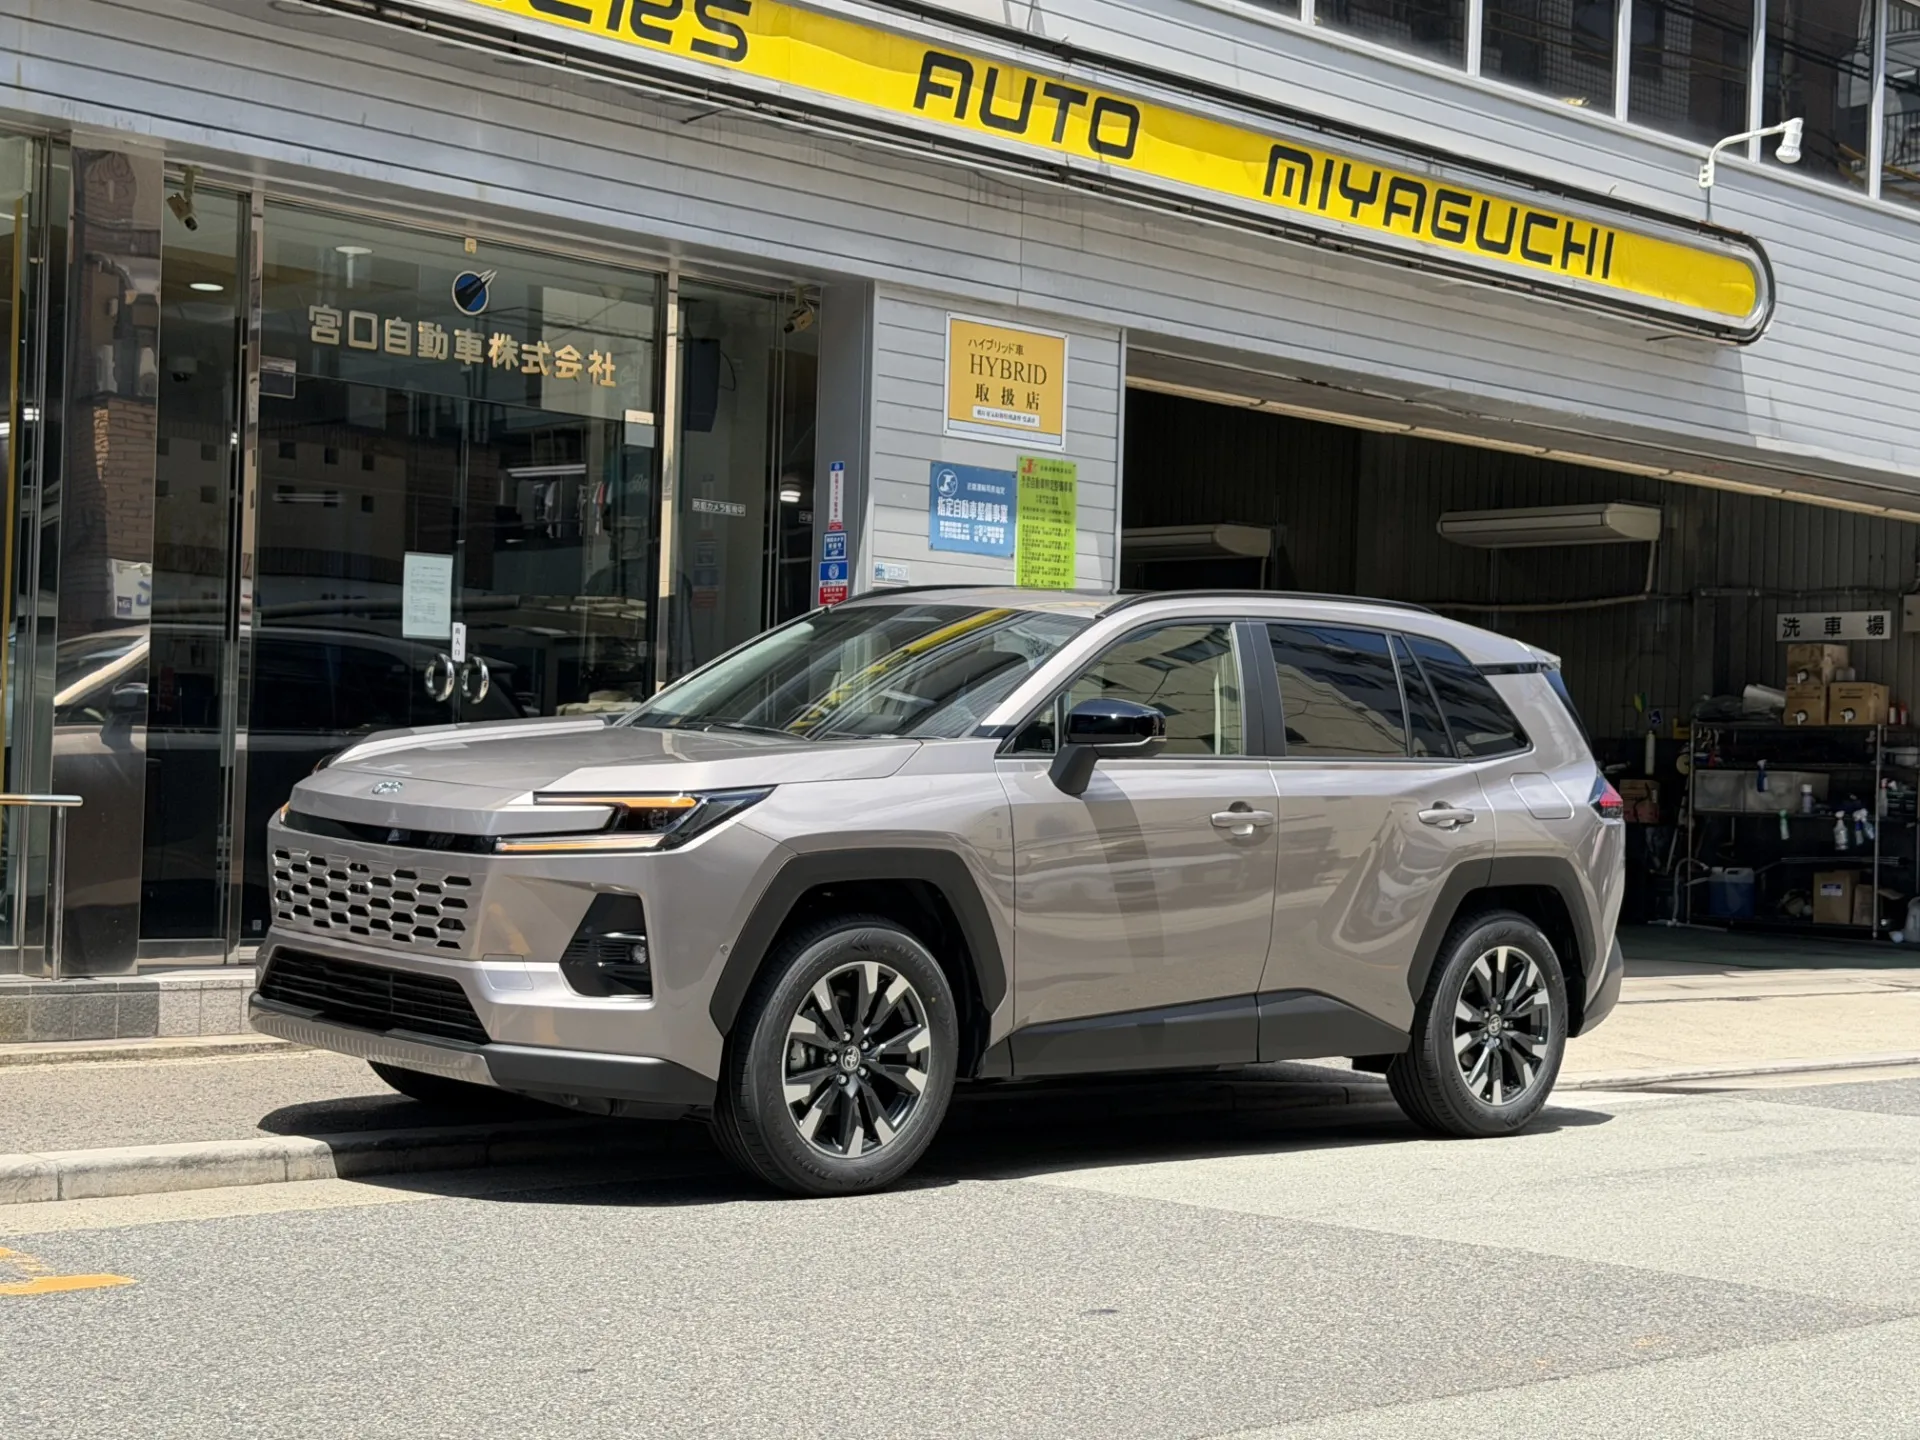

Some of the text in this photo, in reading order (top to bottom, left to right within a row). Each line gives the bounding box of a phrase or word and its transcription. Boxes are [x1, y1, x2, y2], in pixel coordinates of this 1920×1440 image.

[913, 50, 1140, 160] AUTO
[1262, 144, 1618, 280] MIYAGUCHI
[308, 303, 617, 388] 宮口自動車株式会社
[968, 338, 1024, 356] ハイブリッド車
[969, 353, 1048, 386] HYBRID
[975, 383, 1040, 411] 取扱店
[937, 496, 1009, 524] 指定自動車整備事業
[1782, 615, 1885, 639] 洗車場
